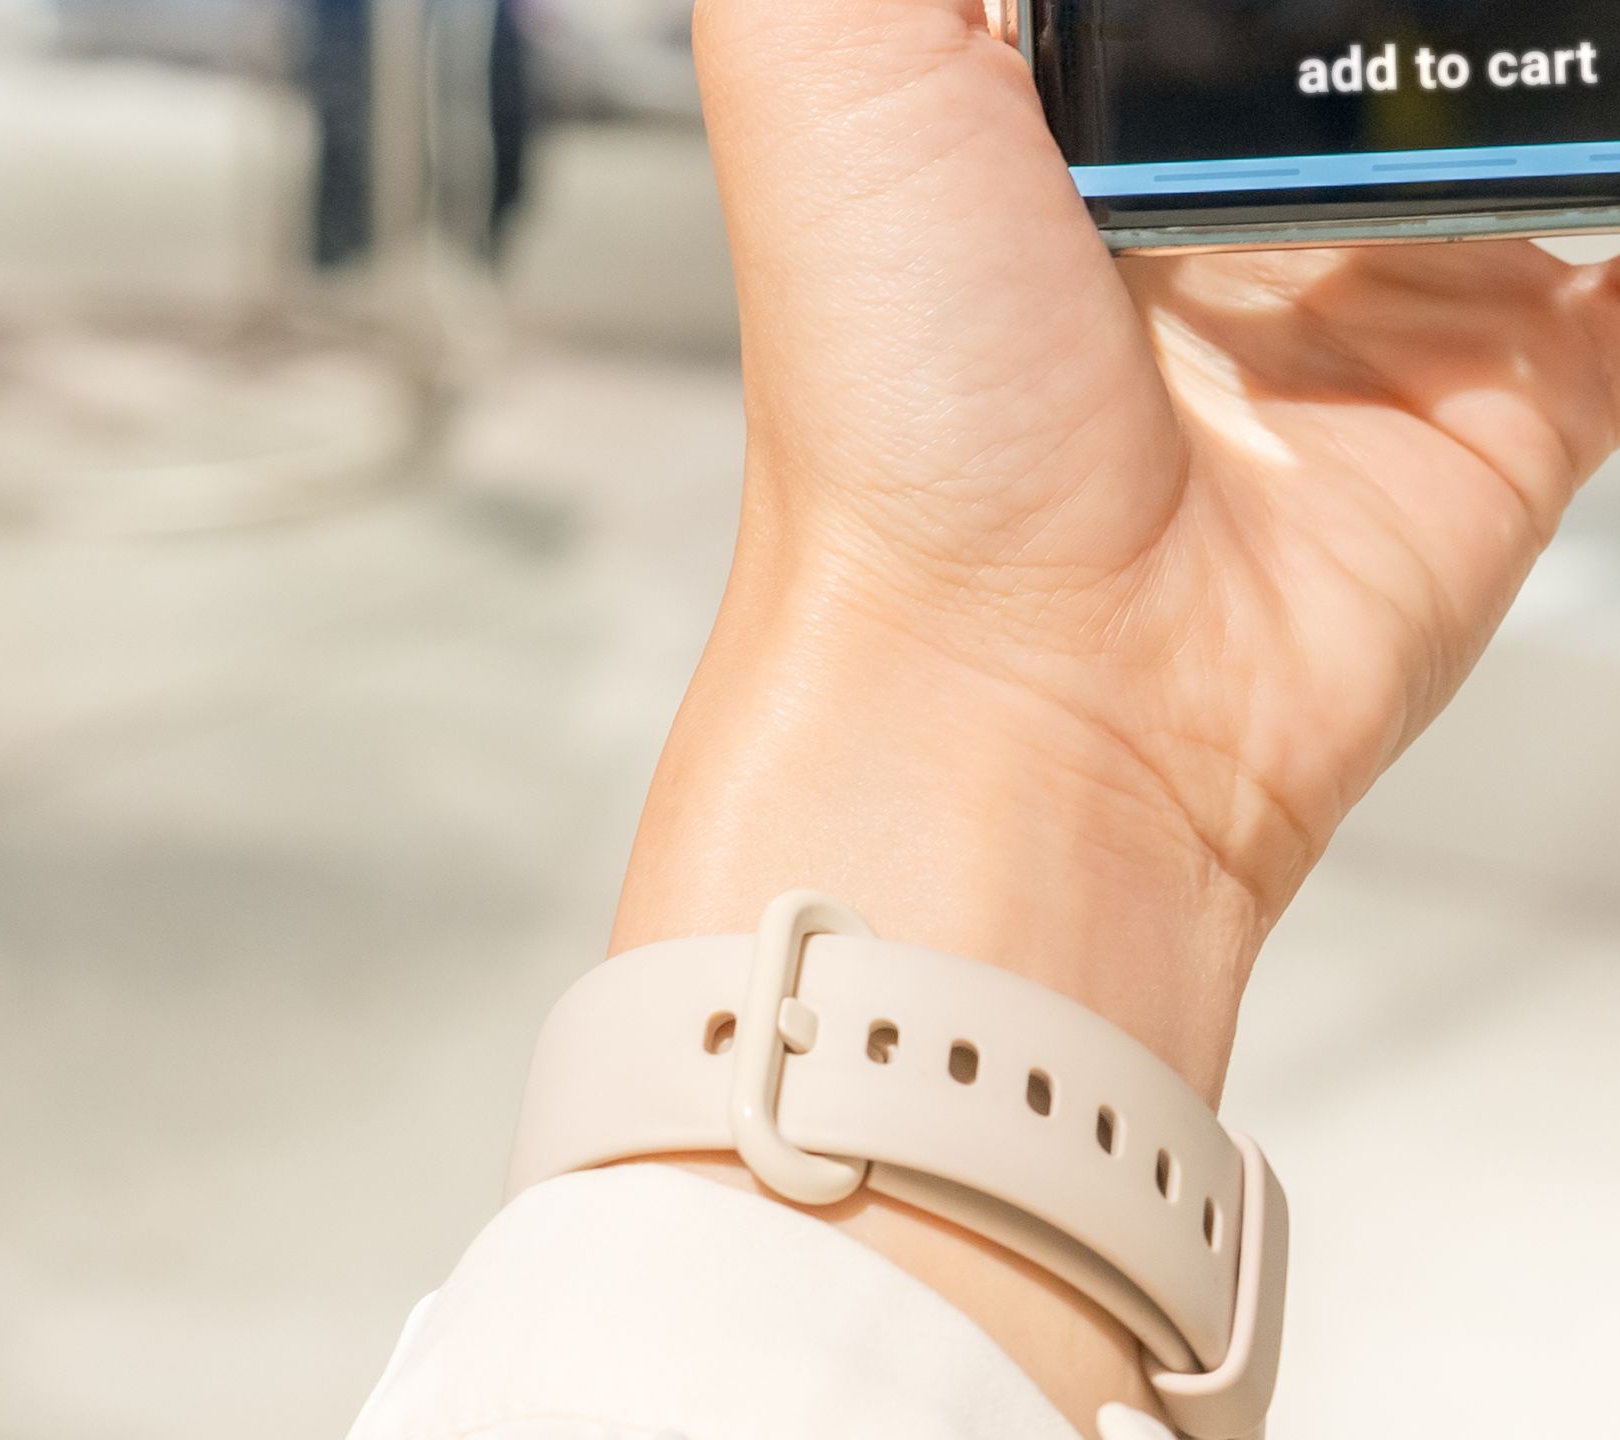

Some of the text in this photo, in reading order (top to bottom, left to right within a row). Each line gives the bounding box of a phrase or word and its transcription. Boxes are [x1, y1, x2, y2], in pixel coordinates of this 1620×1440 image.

[1298, 41, 1599, 94] add to cart
